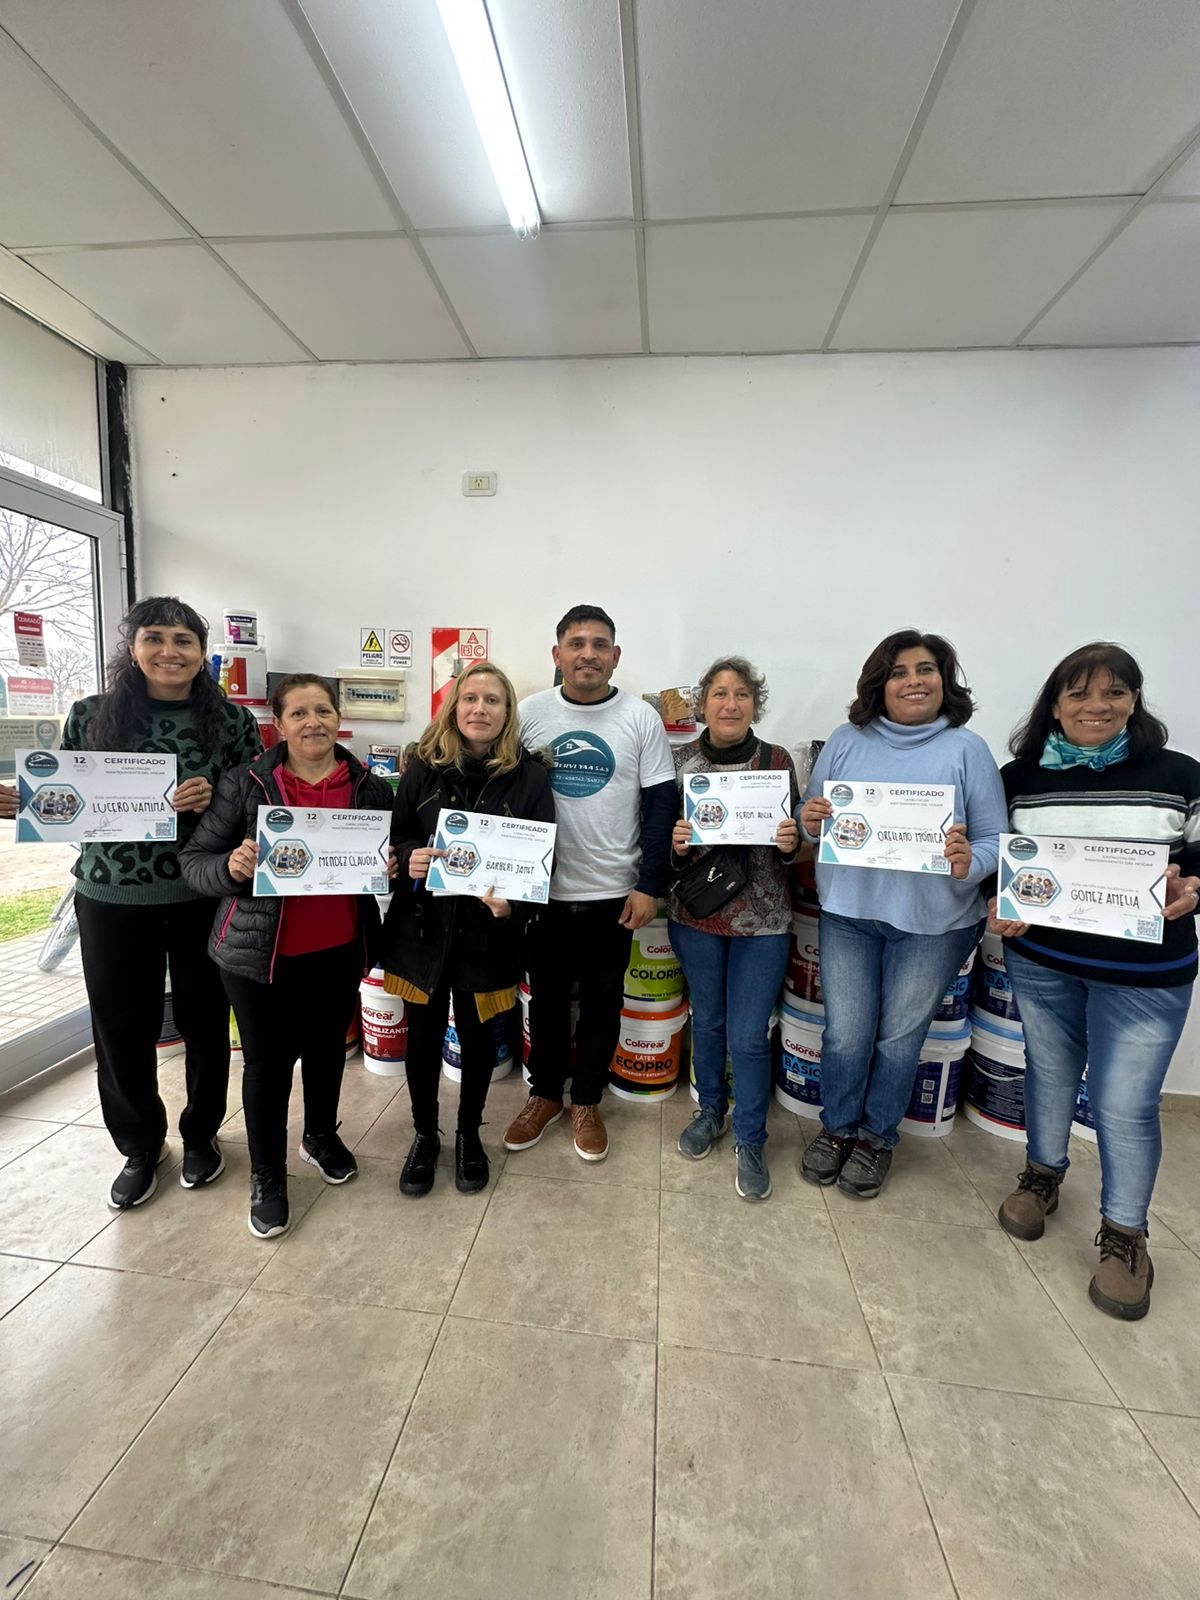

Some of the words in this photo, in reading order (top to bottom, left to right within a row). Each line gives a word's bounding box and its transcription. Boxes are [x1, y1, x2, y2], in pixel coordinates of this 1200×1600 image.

[74, 756, 87, 764] 12
[104, 757, 166, 765] CERTIFICADO
[889, 789, 945, 797] CERTIFICADO
[92, 801, 130, 814] LUCERO
[130, 801, 165, 813] VANINA
[307, 812, 317, 820] 12
[331, 814, 383, 822] CERTIFICADO
[501, 822, 548, 834] CERTIFICADO
[877, 830, 913, 842] ORELLANO
[915, 830, 943, 843] MÓNICA
[1084, 845, 1156, 857] CERTIFICADO
[318, 855, 347, 868] MENDEZ
[348, 855, 378, 867] CLAUDIA
[1070, 889, 1103, 905] GOMEZ
[1106, 893, 1140, 910] AMELIA
[625, 1038, 665, 1049] Colorear
[616, 1055, 673, 1072] ECOPRO
